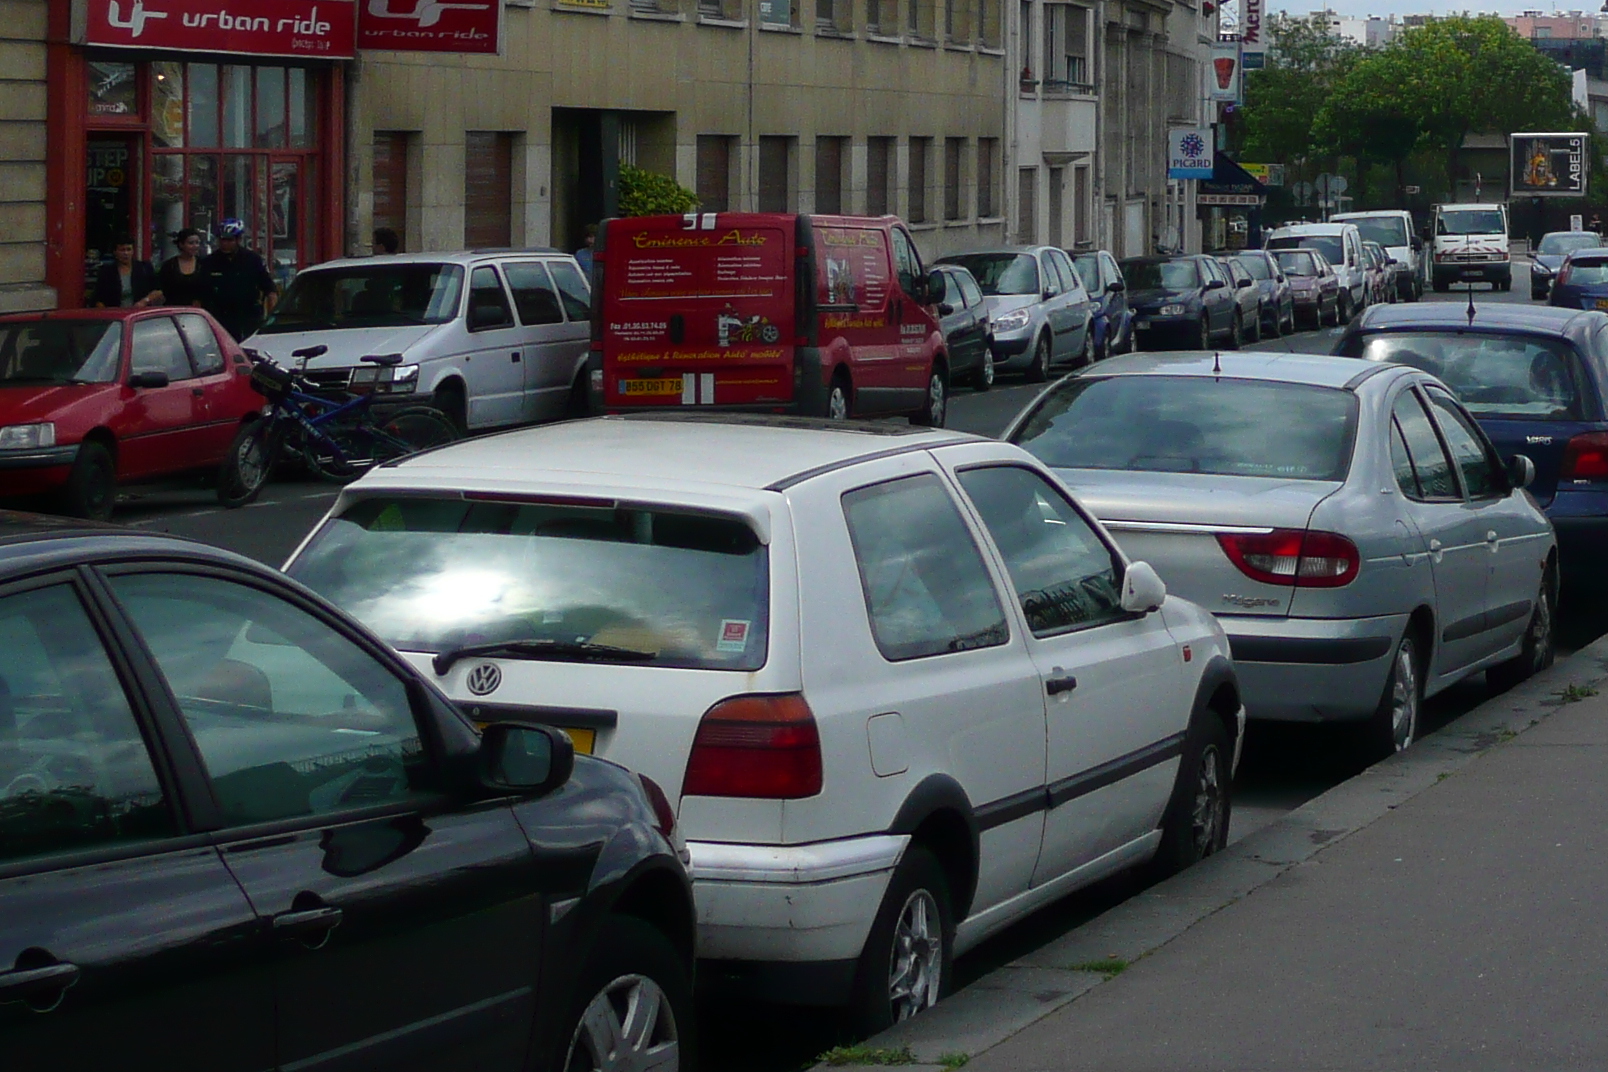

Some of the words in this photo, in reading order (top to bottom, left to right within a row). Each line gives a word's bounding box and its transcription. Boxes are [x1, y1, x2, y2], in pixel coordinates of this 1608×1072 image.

[183, 9, 269, 33] urban
[277, 6, 330, 36] ride
[364, 29, 434, 38] urban
[438, 27, 488, 40] ride
[718, 229, 768, 245] Auto
[625, 381, 645, 392] 855
[669, 380, 682, 391] 78
